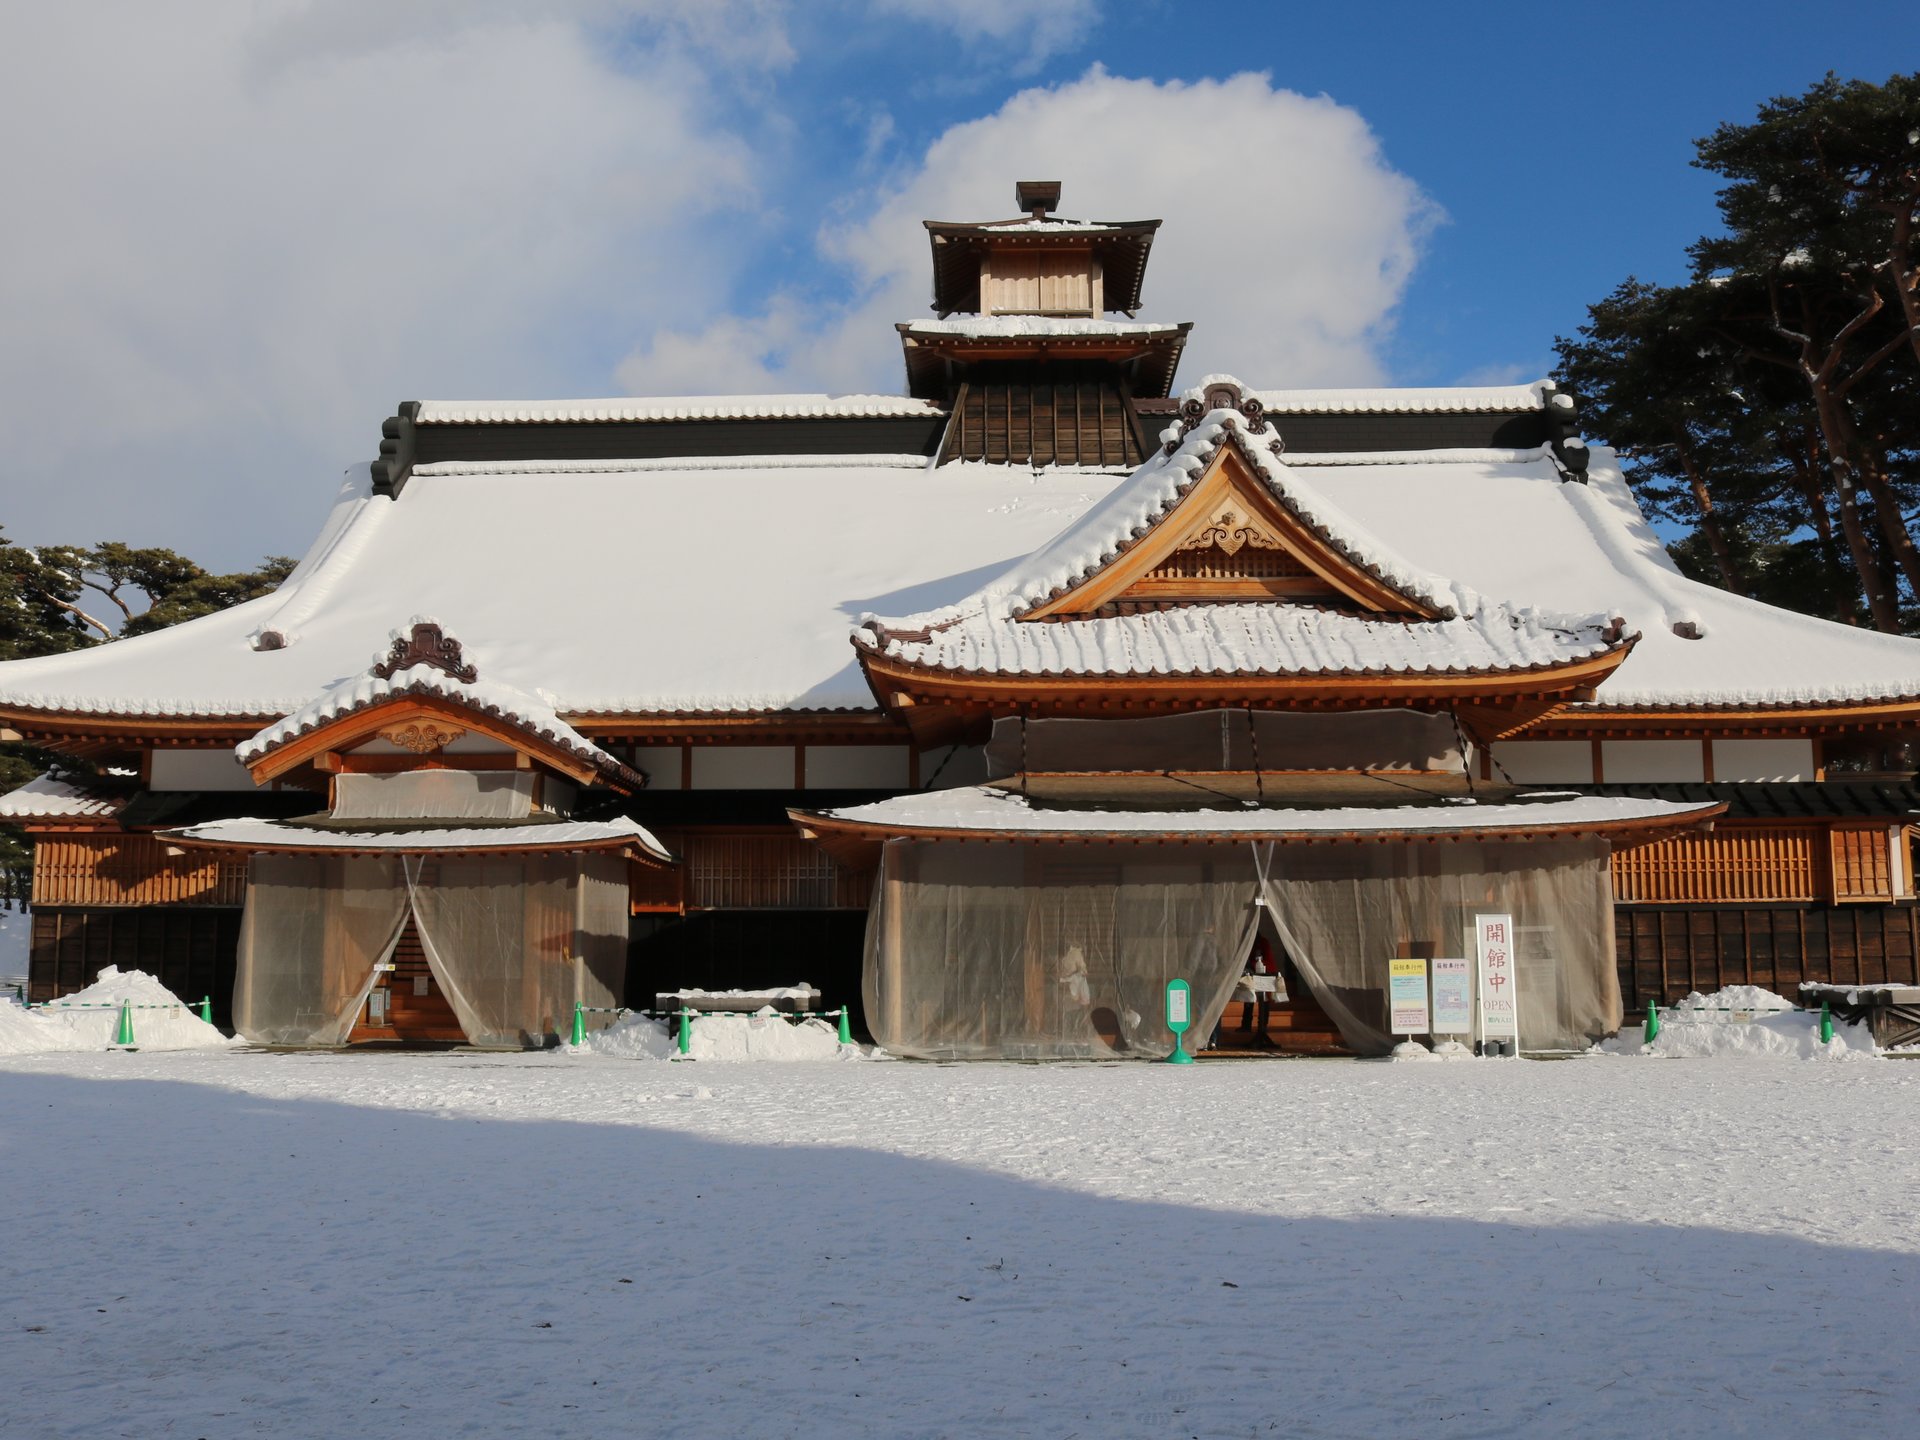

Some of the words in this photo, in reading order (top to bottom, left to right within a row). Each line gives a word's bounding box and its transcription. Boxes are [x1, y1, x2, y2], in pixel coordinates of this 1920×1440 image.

[1486, 923, 1506, 994] 開館中
[1483, 1000, 1512, 1010] OPEN
